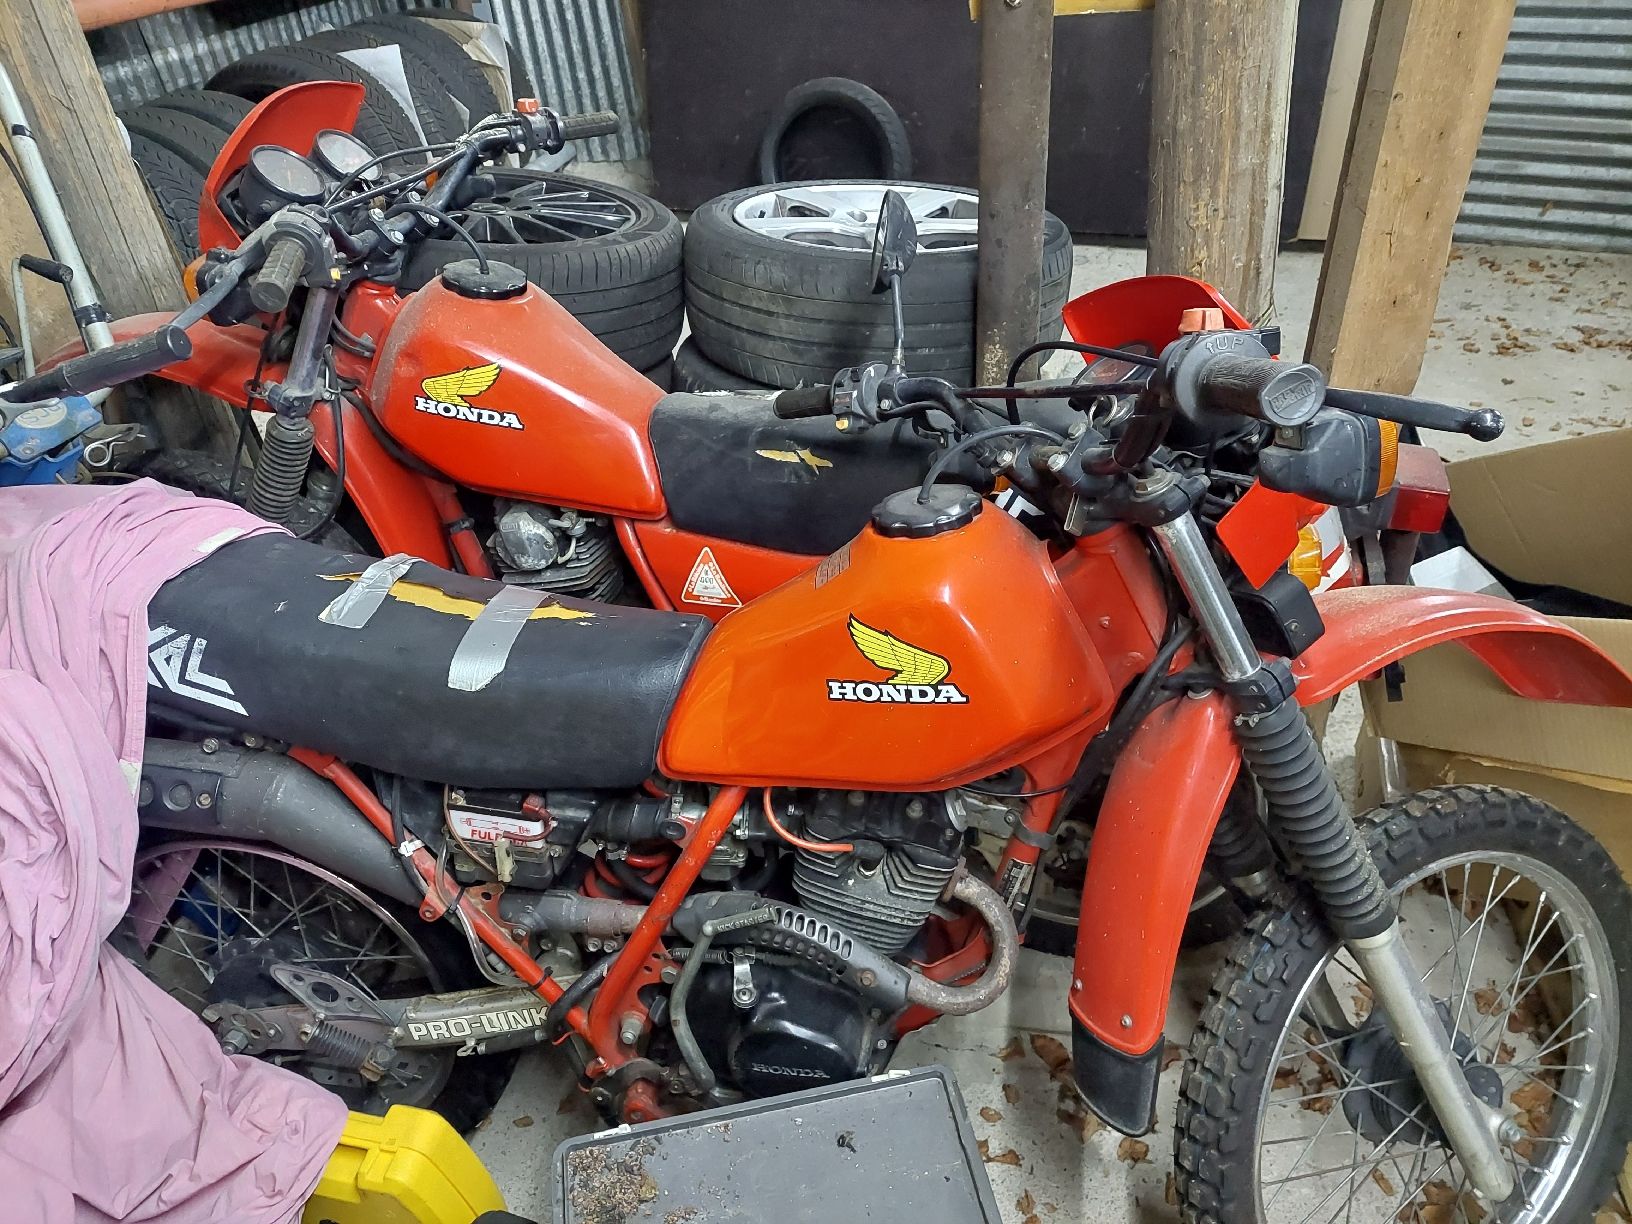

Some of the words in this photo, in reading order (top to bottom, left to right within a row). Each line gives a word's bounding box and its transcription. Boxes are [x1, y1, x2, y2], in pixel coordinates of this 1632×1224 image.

[1216, 336, 1244, 350] UP
[414, 396, 525, 430] HONDA
[828, 680, 968, 704] HONDA
[407, 1006, 549, 1041] PRO-LINK
[751, 1062, 831, 1079] HONDA
